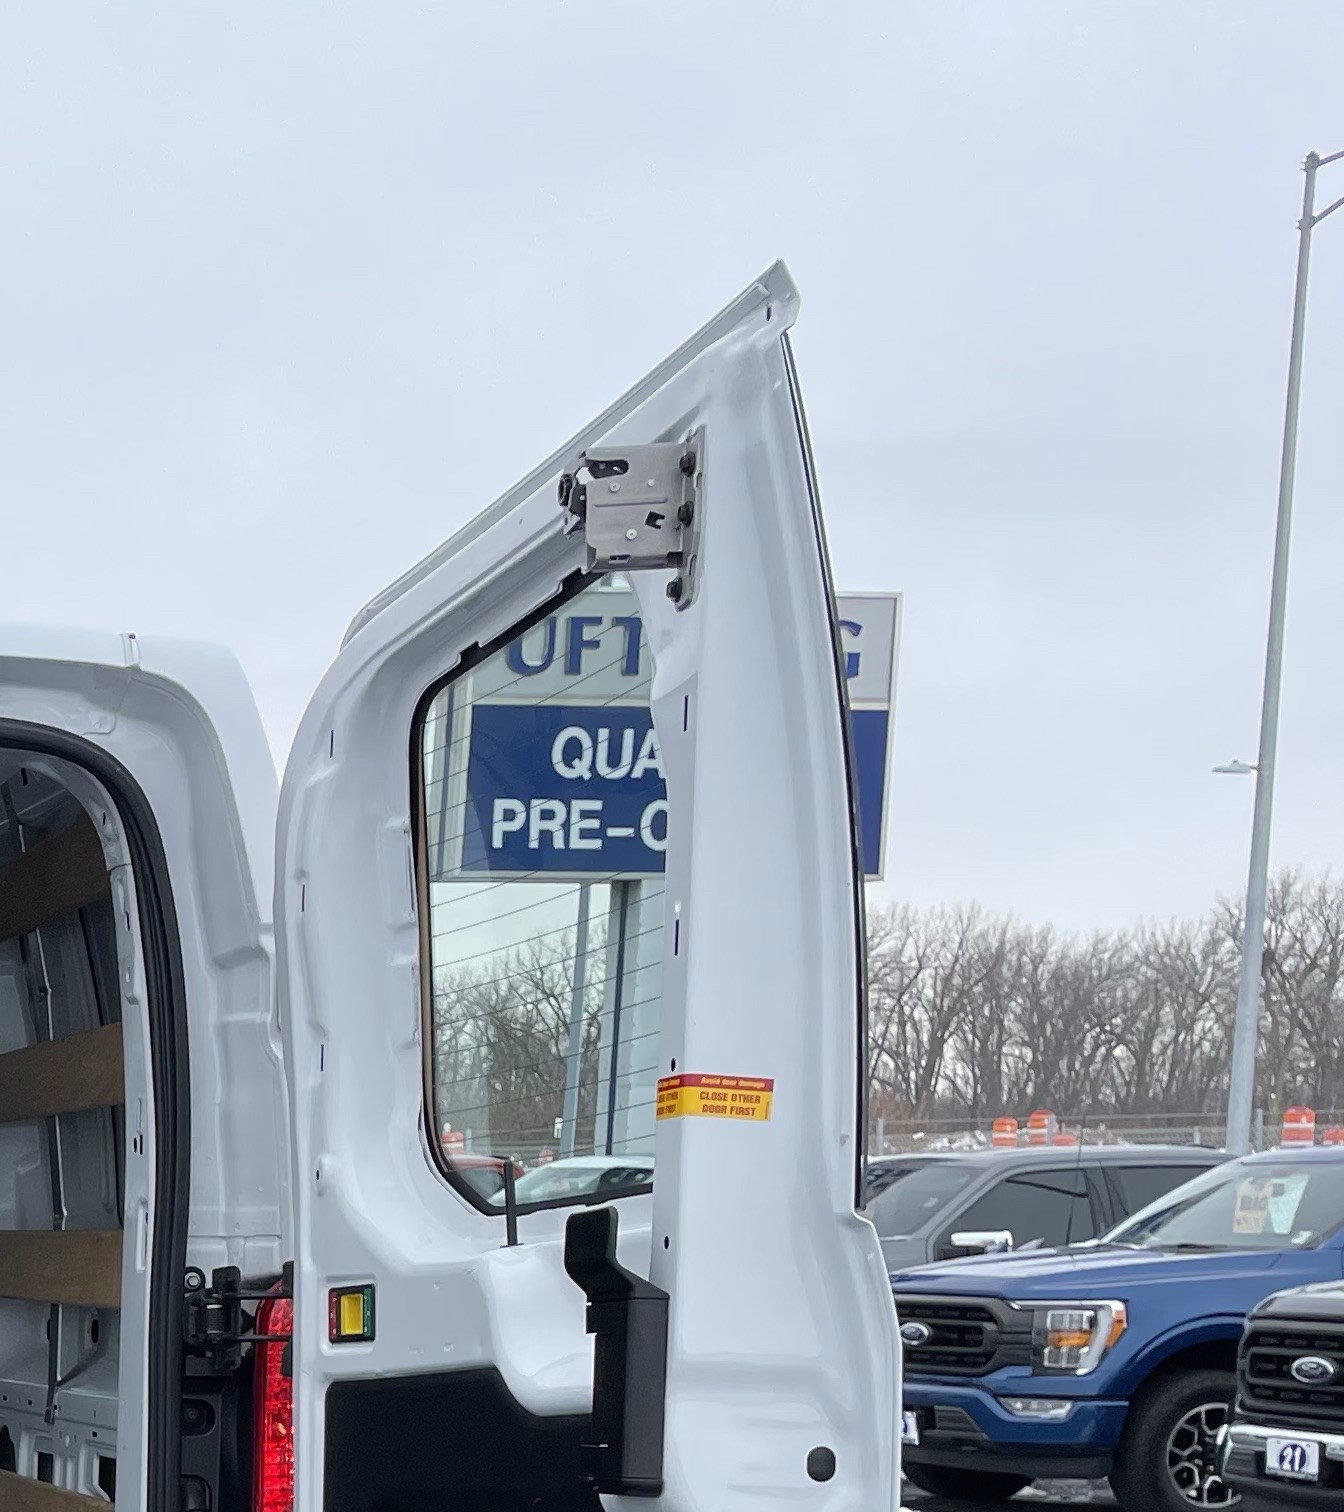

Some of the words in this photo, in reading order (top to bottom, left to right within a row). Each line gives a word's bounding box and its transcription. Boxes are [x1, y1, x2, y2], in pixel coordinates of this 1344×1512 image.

[492, 798, 668, 851] PRE-O
[699, 1091, 729, 1102] CLOSE
[731, 1093, 761, 1104] OTHER
[702, 1104, 727, 1114] DOOR
[730, 1106, 757, 1116] FIRST
